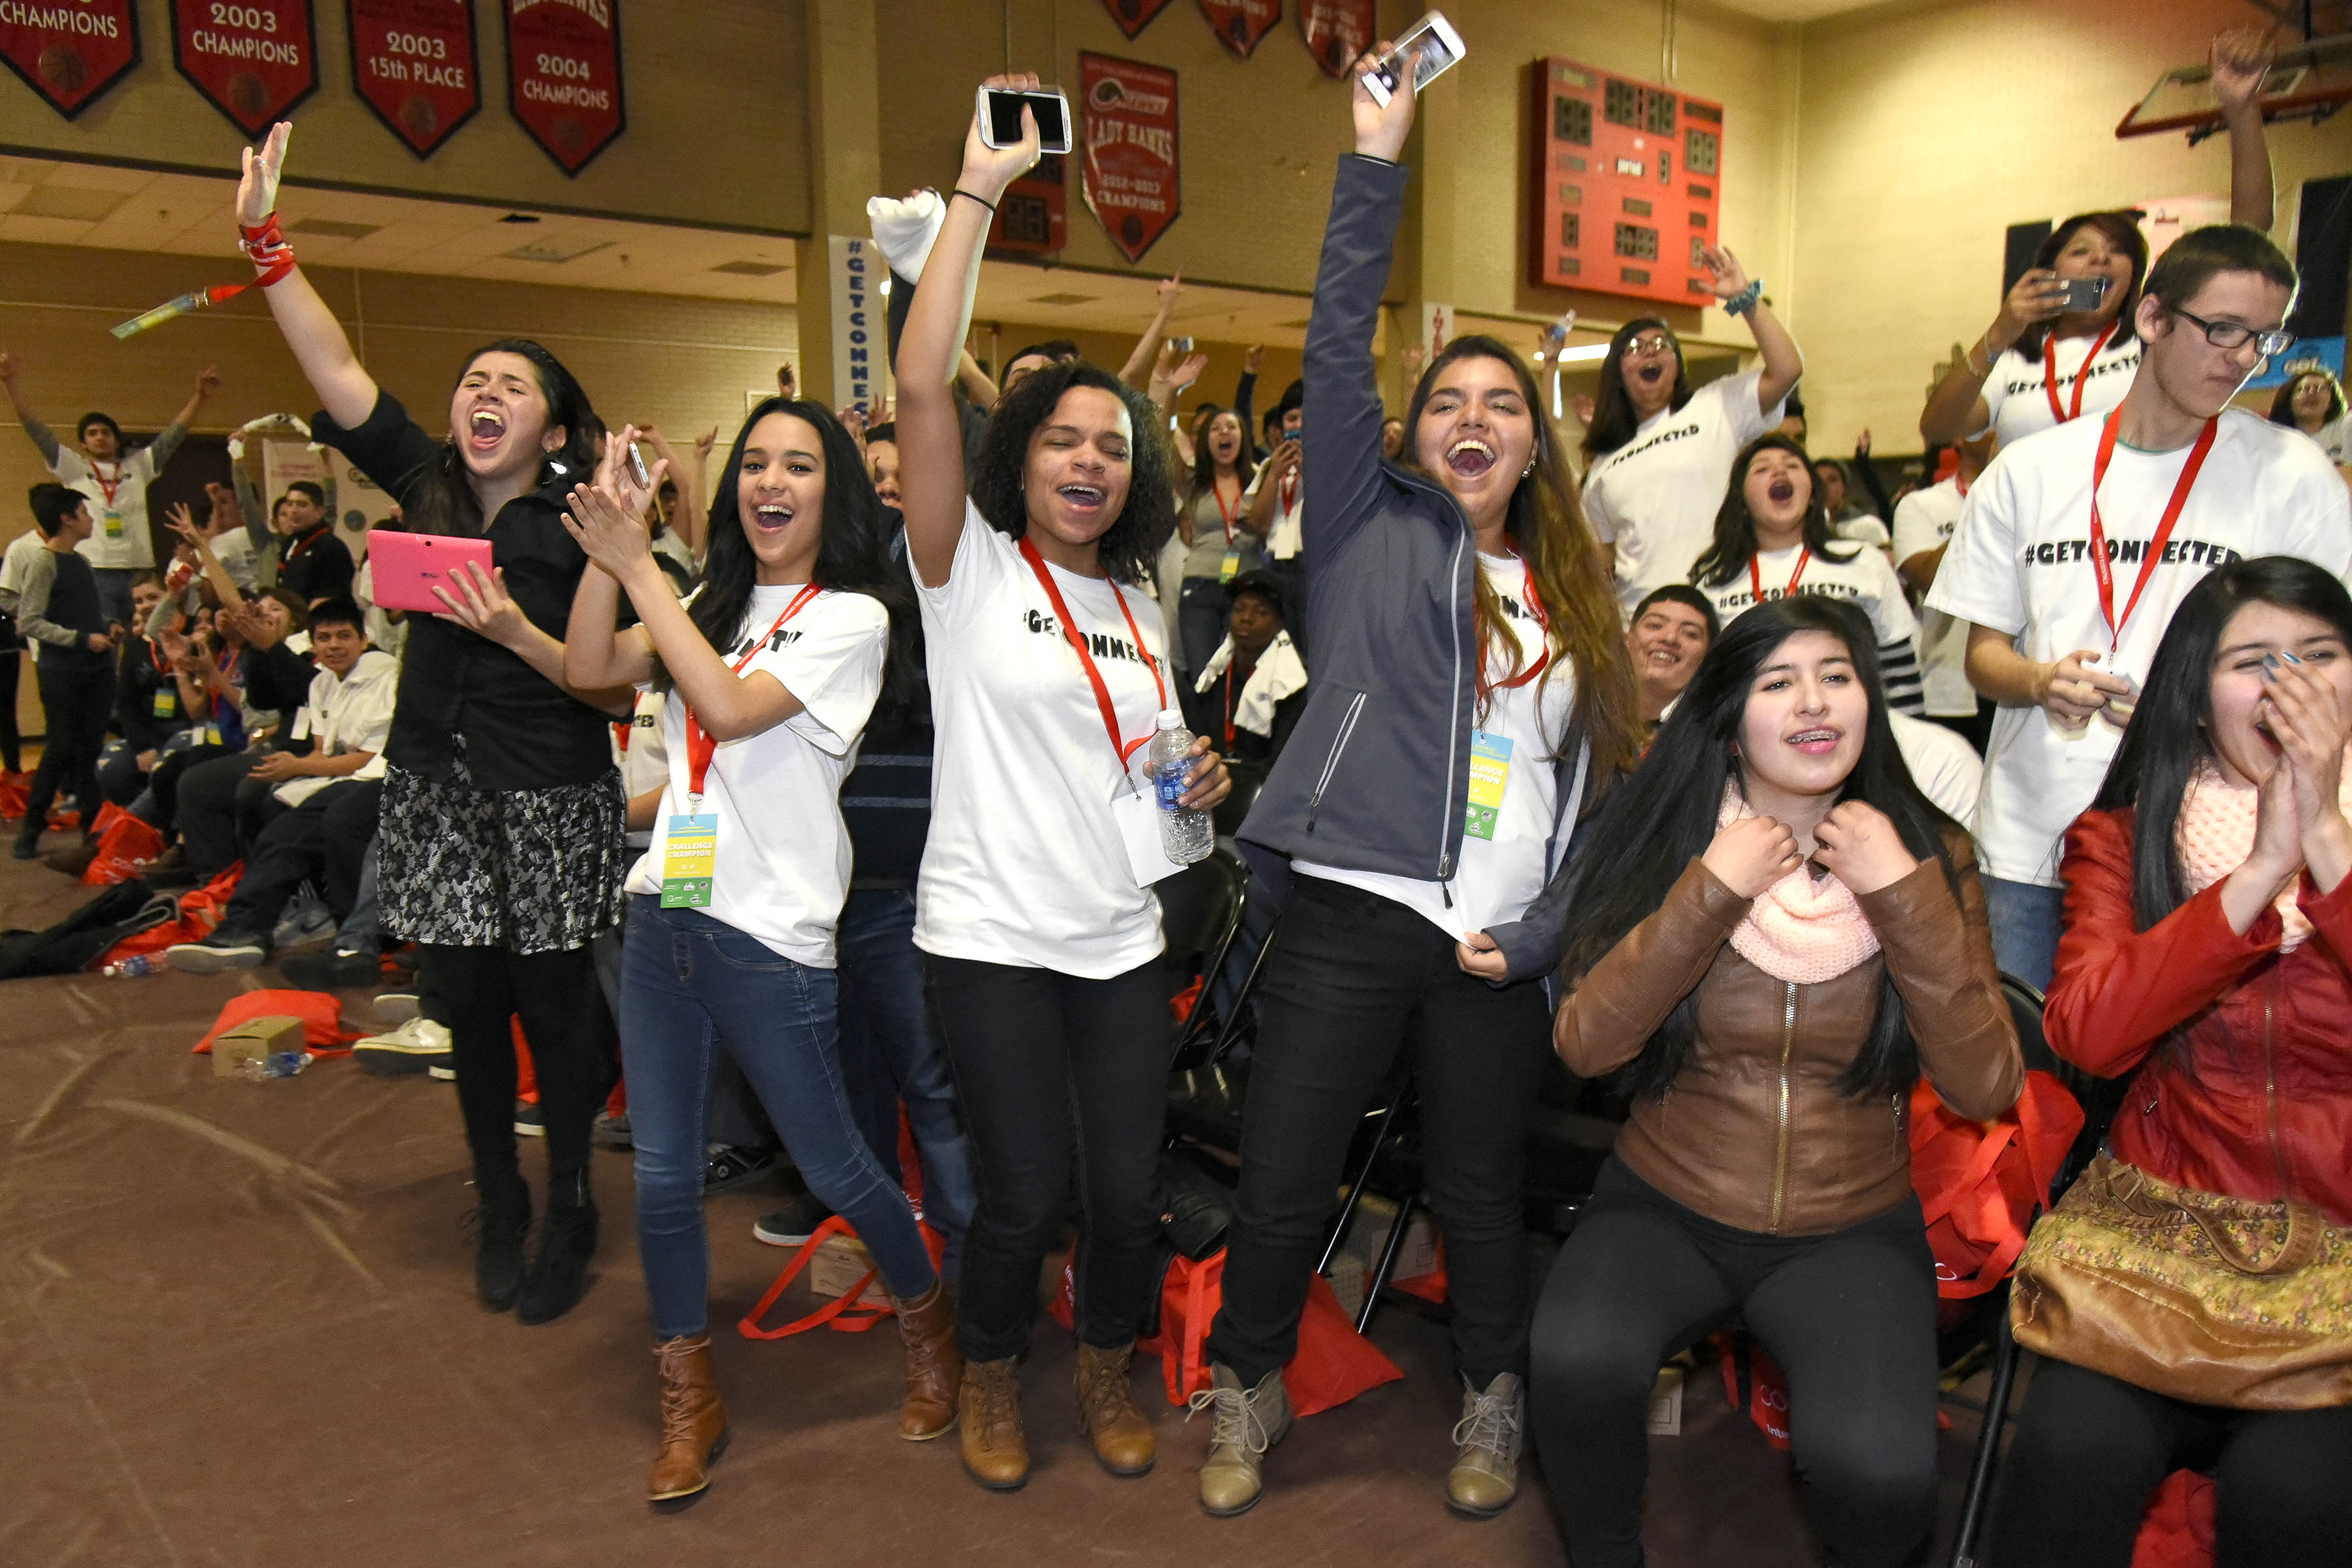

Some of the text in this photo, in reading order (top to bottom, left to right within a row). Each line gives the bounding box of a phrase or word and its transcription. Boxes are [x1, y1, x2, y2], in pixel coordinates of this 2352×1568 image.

[0, 1, 119, 39] CHAMPIONS
[210, 3, 277, 32] 2003
[193, 29, 299, 65] CHAMPIONS
[386, 31, 446, 59] 2003
[369, 56, 466, 89] 15th PLACE
[536, 53, 590, 81] 2004
[523, 78, 609, 110] CHAMPIONS
